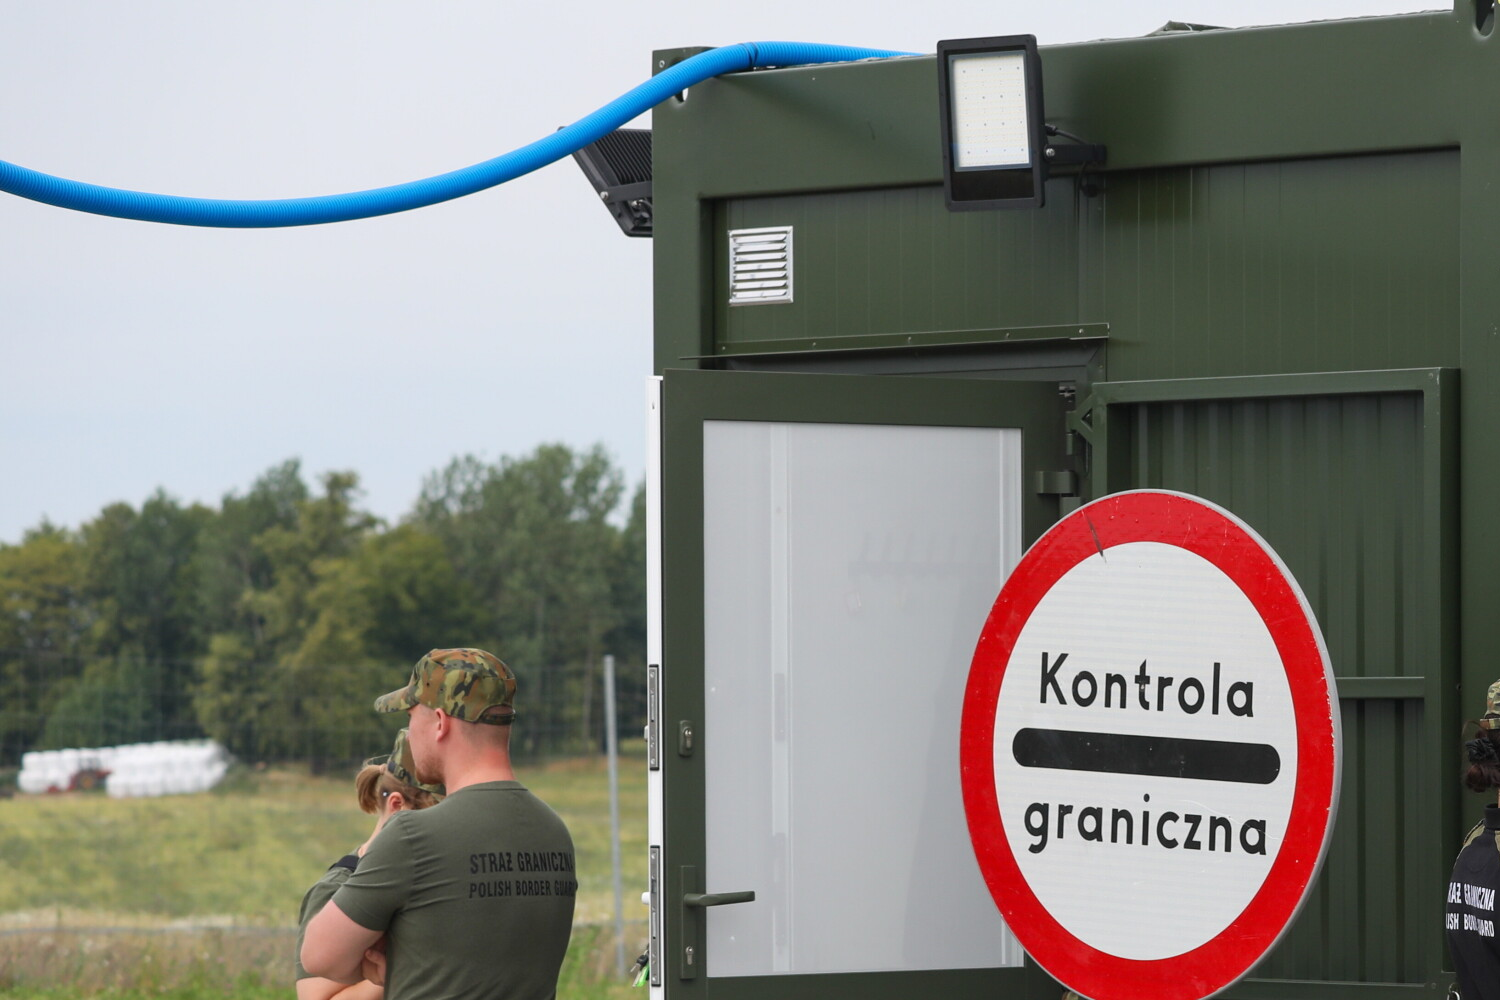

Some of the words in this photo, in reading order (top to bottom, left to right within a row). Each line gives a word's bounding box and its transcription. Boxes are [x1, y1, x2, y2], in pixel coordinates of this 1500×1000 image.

[1040, 651, 1254, 718] Kontrola
[1024, 793, 1266, 855] graniczna
[469, 880, 512, 898] POLISH
[515, 880, 552, 897] BORDER
